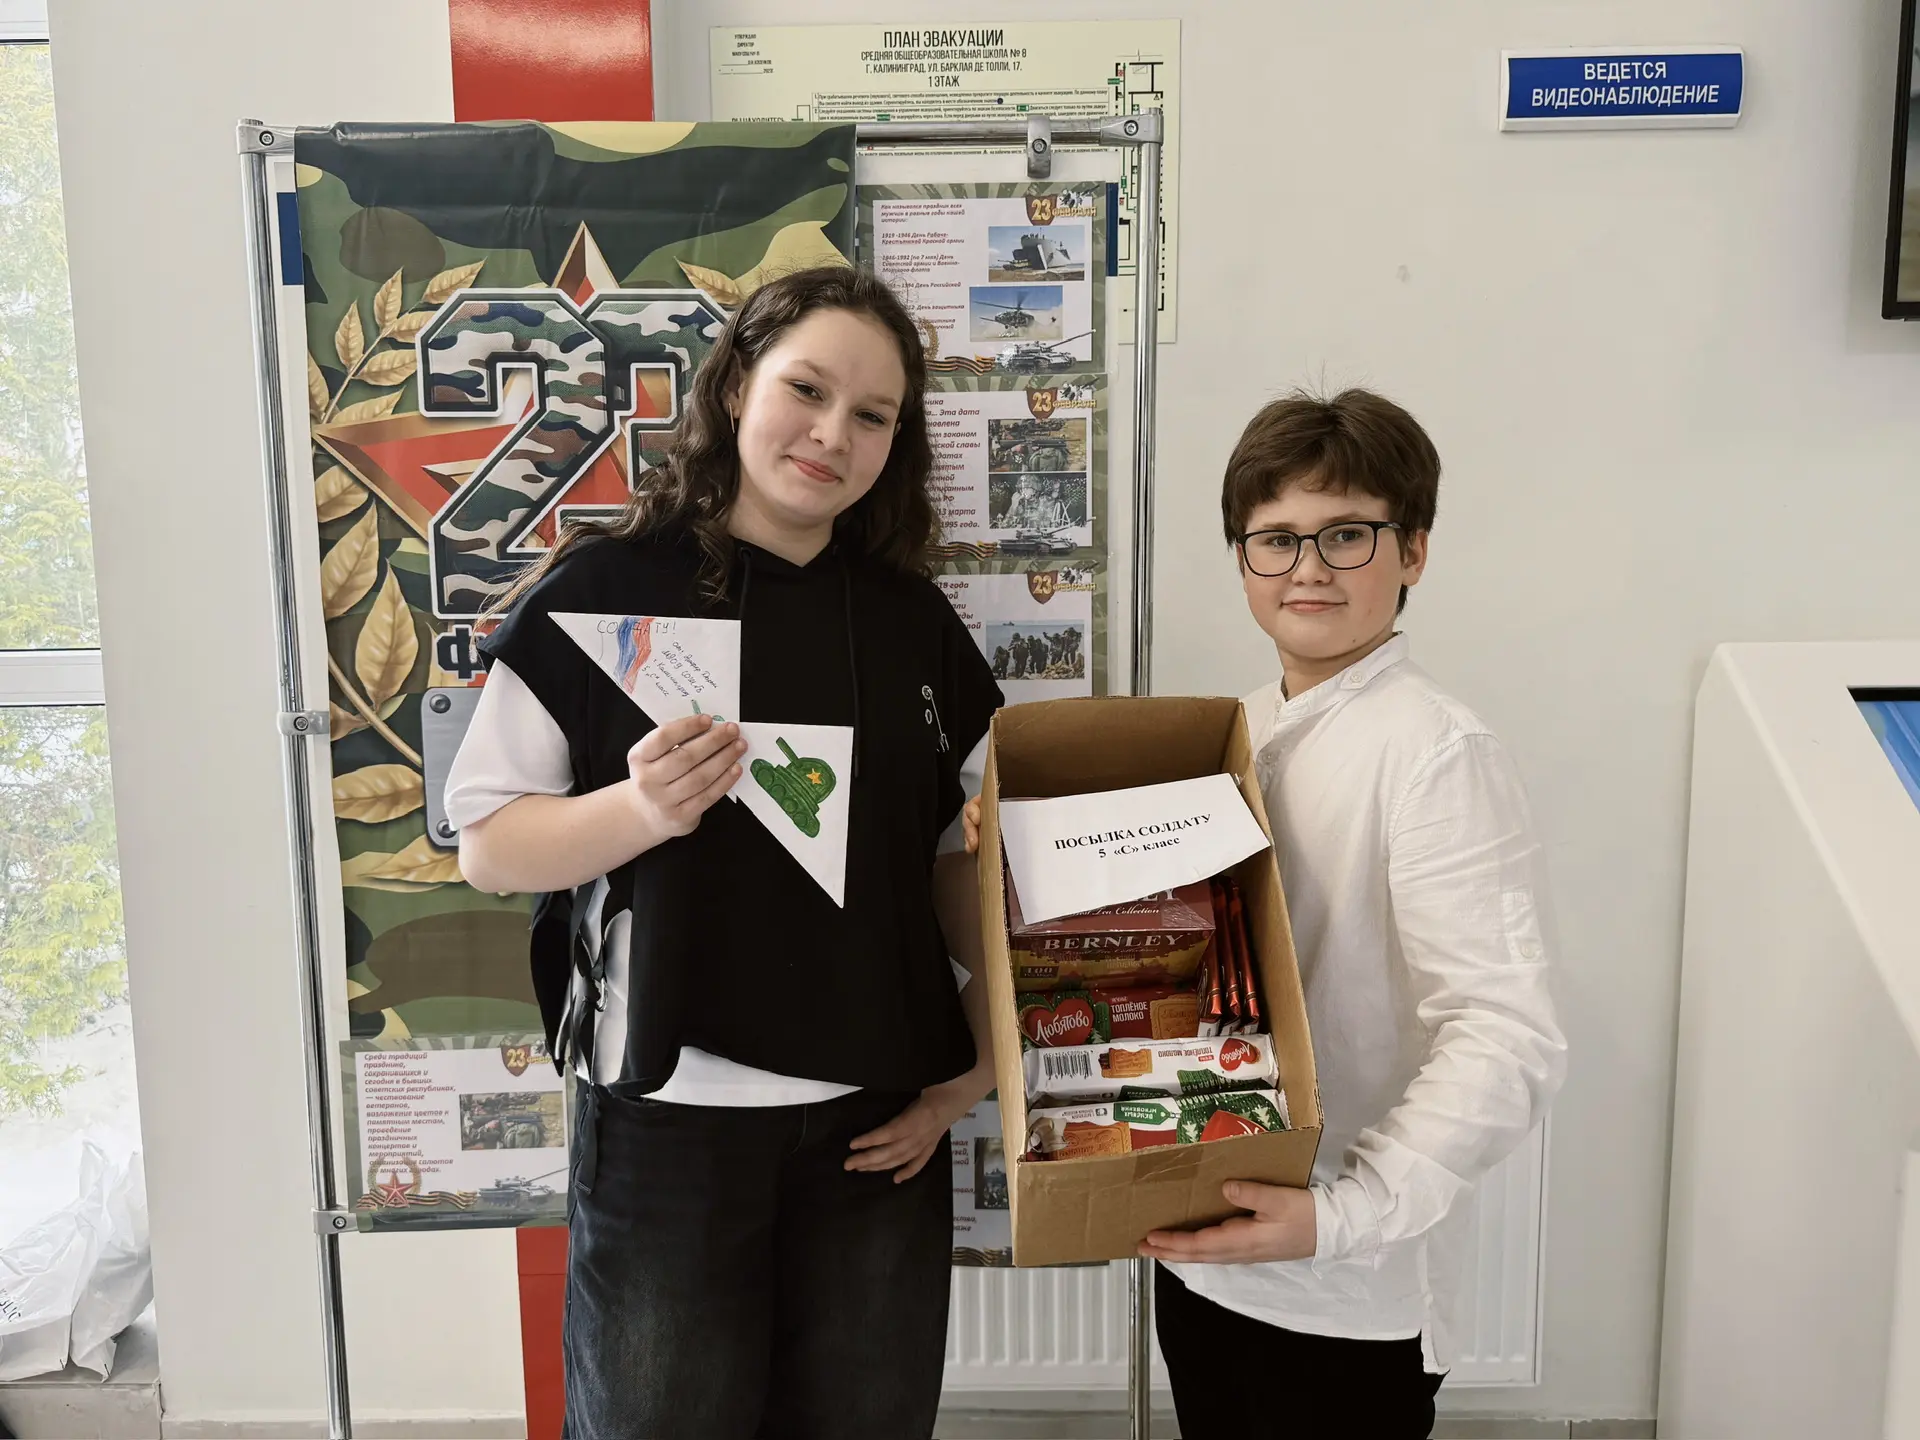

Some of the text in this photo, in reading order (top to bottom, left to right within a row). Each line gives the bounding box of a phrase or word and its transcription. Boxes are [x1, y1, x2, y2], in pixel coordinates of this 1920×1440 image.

[884, 30, 1004, 48] ПЛАН ЭВАКУАЦИИ
[861, 51, 893, 62] СРЕДНЯЯ
[894, 49, 982, 60] ОБЩЕОБРАЗОВАТЕЛЬНАЯ
[982, 49, 1008, 58] ШКОЛА
[1022, 48, 1026, 58] 8
[928, 62, 939, 72] УЛ.
[940, 62, 972, 72] БАРКЛАЯ
[974, 62, 984, 72] ДЕ
[1584, 61, 1667, 84] ВЕДЕТСЯ
[928, 76, 960, 87] 1 ЭТАЖ
[1531, 85, 1720, 110] ВИДЕОНАБЛЮДЕНИЕ
[1032, 198, 1052, 220] 23
[1032, 392, 1052, 412] 23
[1033, 575, 1052, 594] 23
[596, 619, 677, 635] СОДАТУ!
[1054, 814, 1211, 850] ПОСЫЛКА СОЛДАТУ
[1098, 836, 1180, 859] 5 «С» класс
[1116, 904, 1159, 915] Collection
[1044, 934, 1186, 950] BERNLEY
[1111, 1001, 1148, 1014] ТОПЛЁНОЕ
[1112, 1011, 1144, 1022] МОЛОКО
[1035, 1010, 1090, 1046] Любятово
[388, 1052, 428, 1060] традиций
[507, 1049, 526, 1067] 23
[1221, 1042, 1250, 1064] Любятово
[406, 1084, 456, 1093] республиках,
[368, 1126, 412, 1134] проведение
